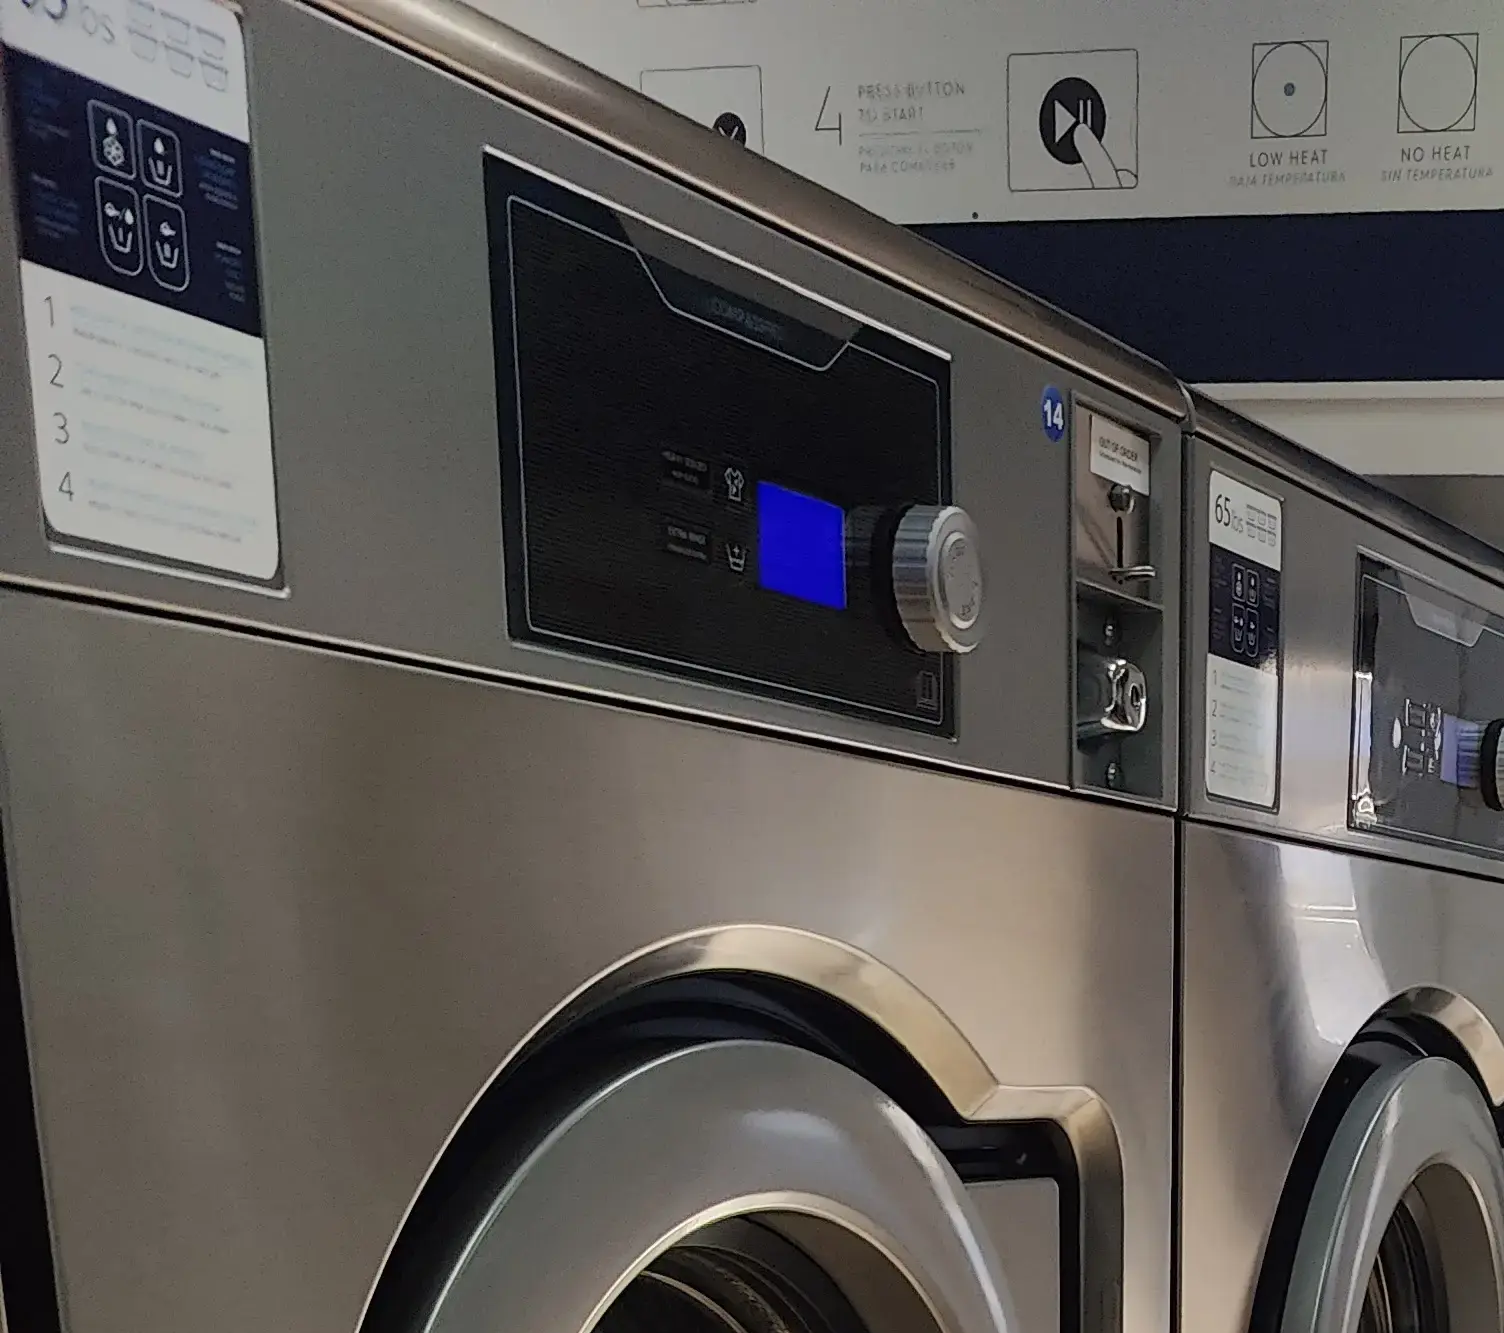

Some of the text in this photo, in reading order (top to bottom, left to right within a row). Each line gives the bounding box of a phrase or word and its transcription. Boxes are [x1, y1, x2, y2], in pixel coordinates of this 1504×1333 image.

[815, 86, 842, 146] 4
[883, 105, 924, 121] START
[1250, 149, 1327, 168] LOW HEAT
[1401, 145, 1471, 163] NO HEAT
[1262, 170, 1346, 187] TEMPERATURA
[1380, 167, 1494, 182] SIN TEMPERATURA
[44, 296, 54, 327] 1
[48, 353, 64, 388] 2
[53, 412, 69, 444] 3
[1043, 399, 1064, 430] 14
[59, 471, 74, 502] 4
[1215, 494, 1231, 526] 65
